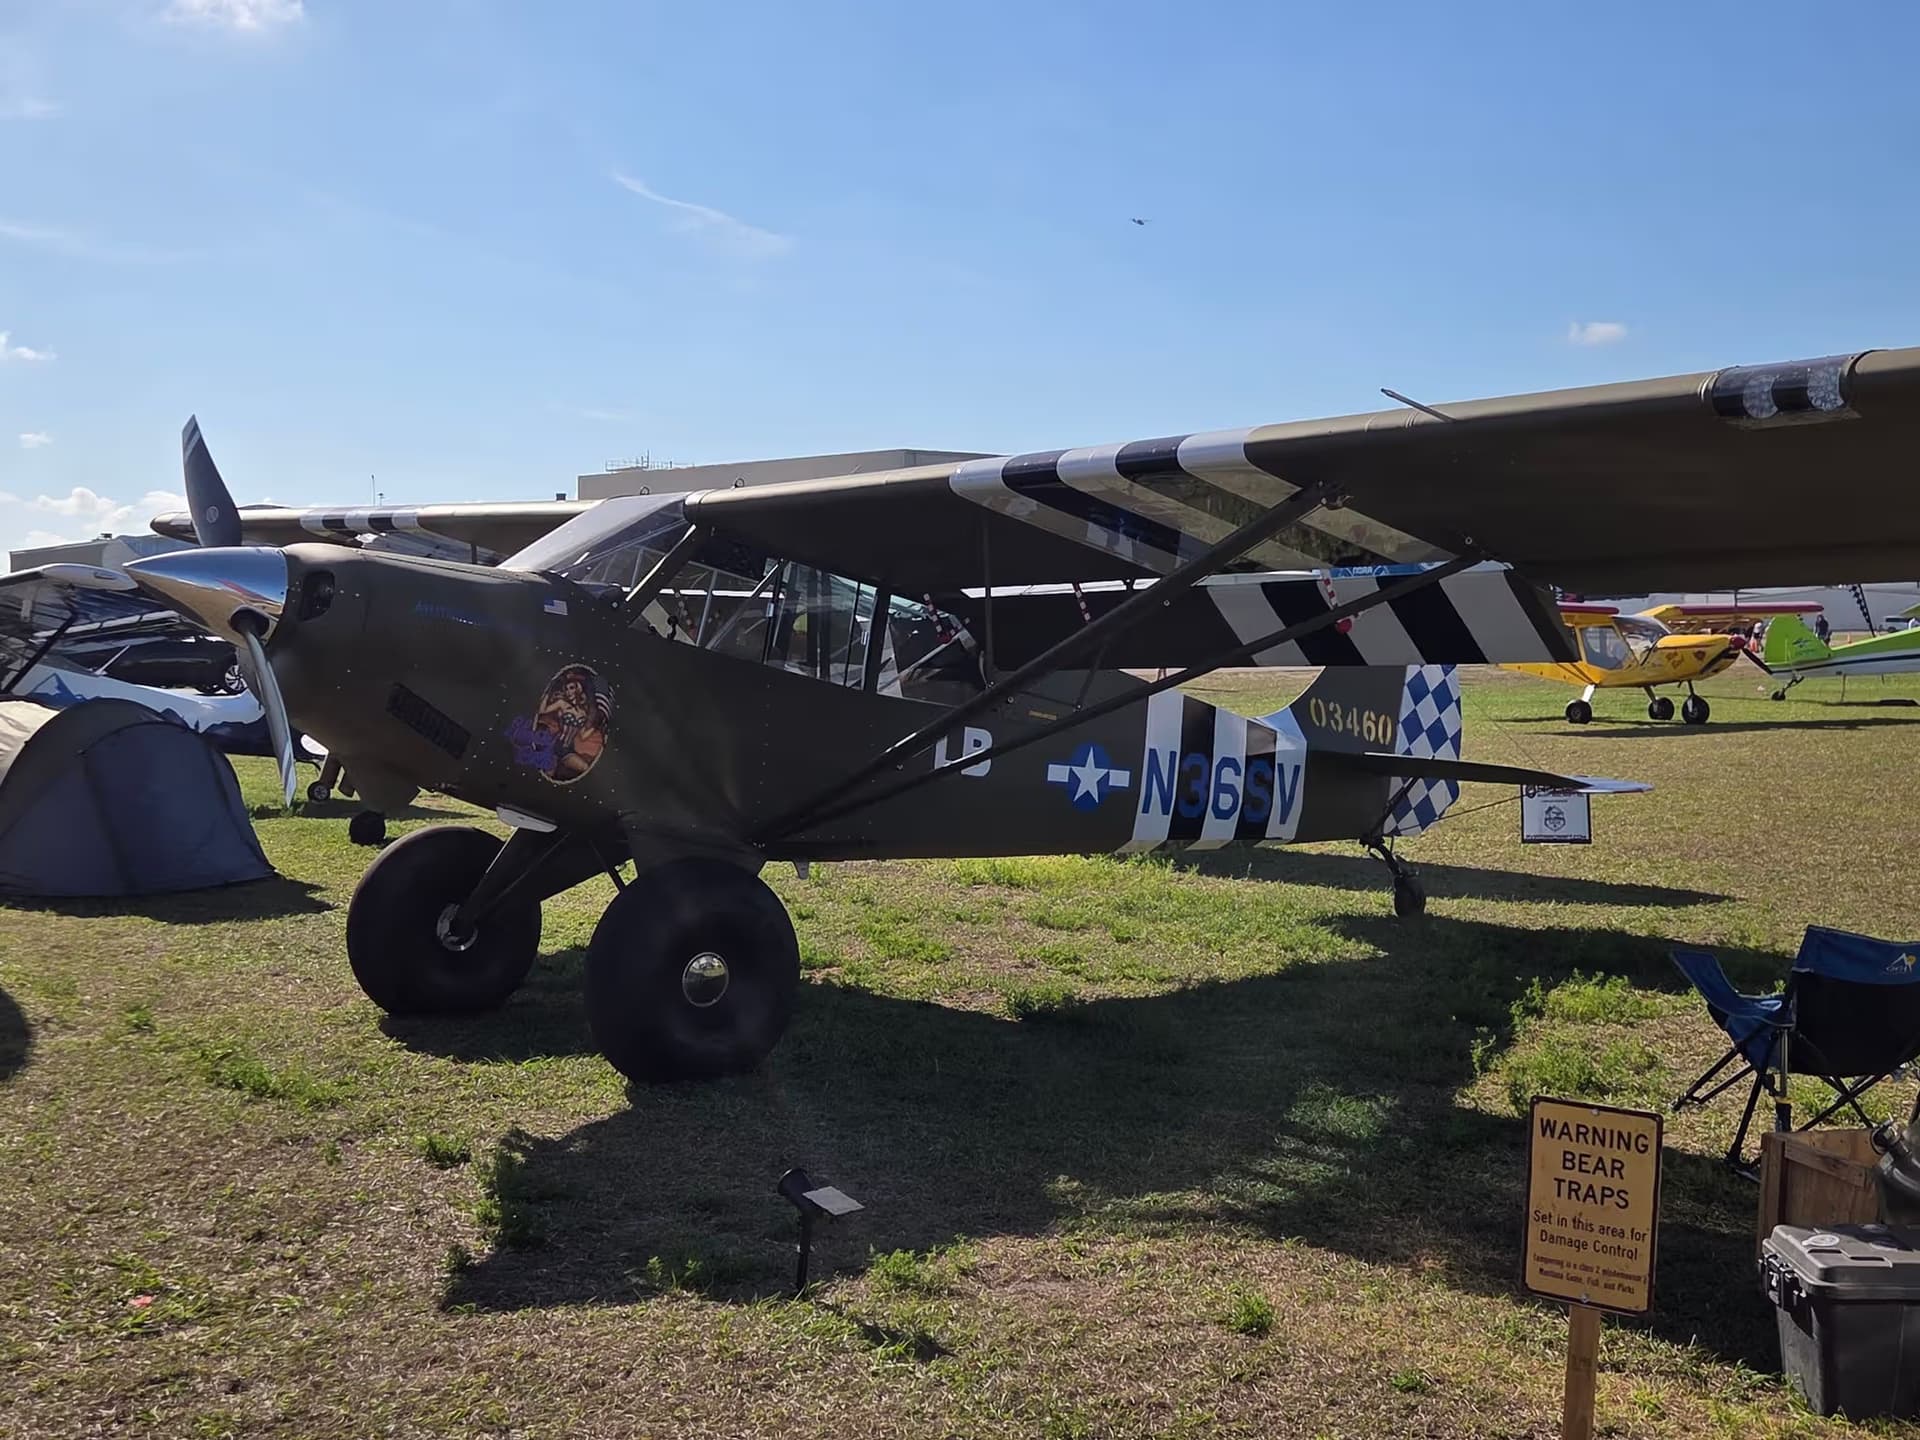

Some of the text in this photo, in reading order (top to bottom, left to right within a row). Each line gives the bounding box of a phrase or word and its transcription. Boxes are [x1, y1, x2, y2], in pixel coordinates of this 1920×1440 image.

[1310, 697, 1392, 746] 03460
[1141, 748, 1300, 824] N36SV
[1540, 1117, 1649, 1154] WARNING
[1562, 1150, 1625, 1180] BEAR
[1553, 1177, 1629, 1209] TRAPS
[1533, 1209, 1648, 1243] Set in this area for
[1540, 1229, 1638, 1261] Damage Control
